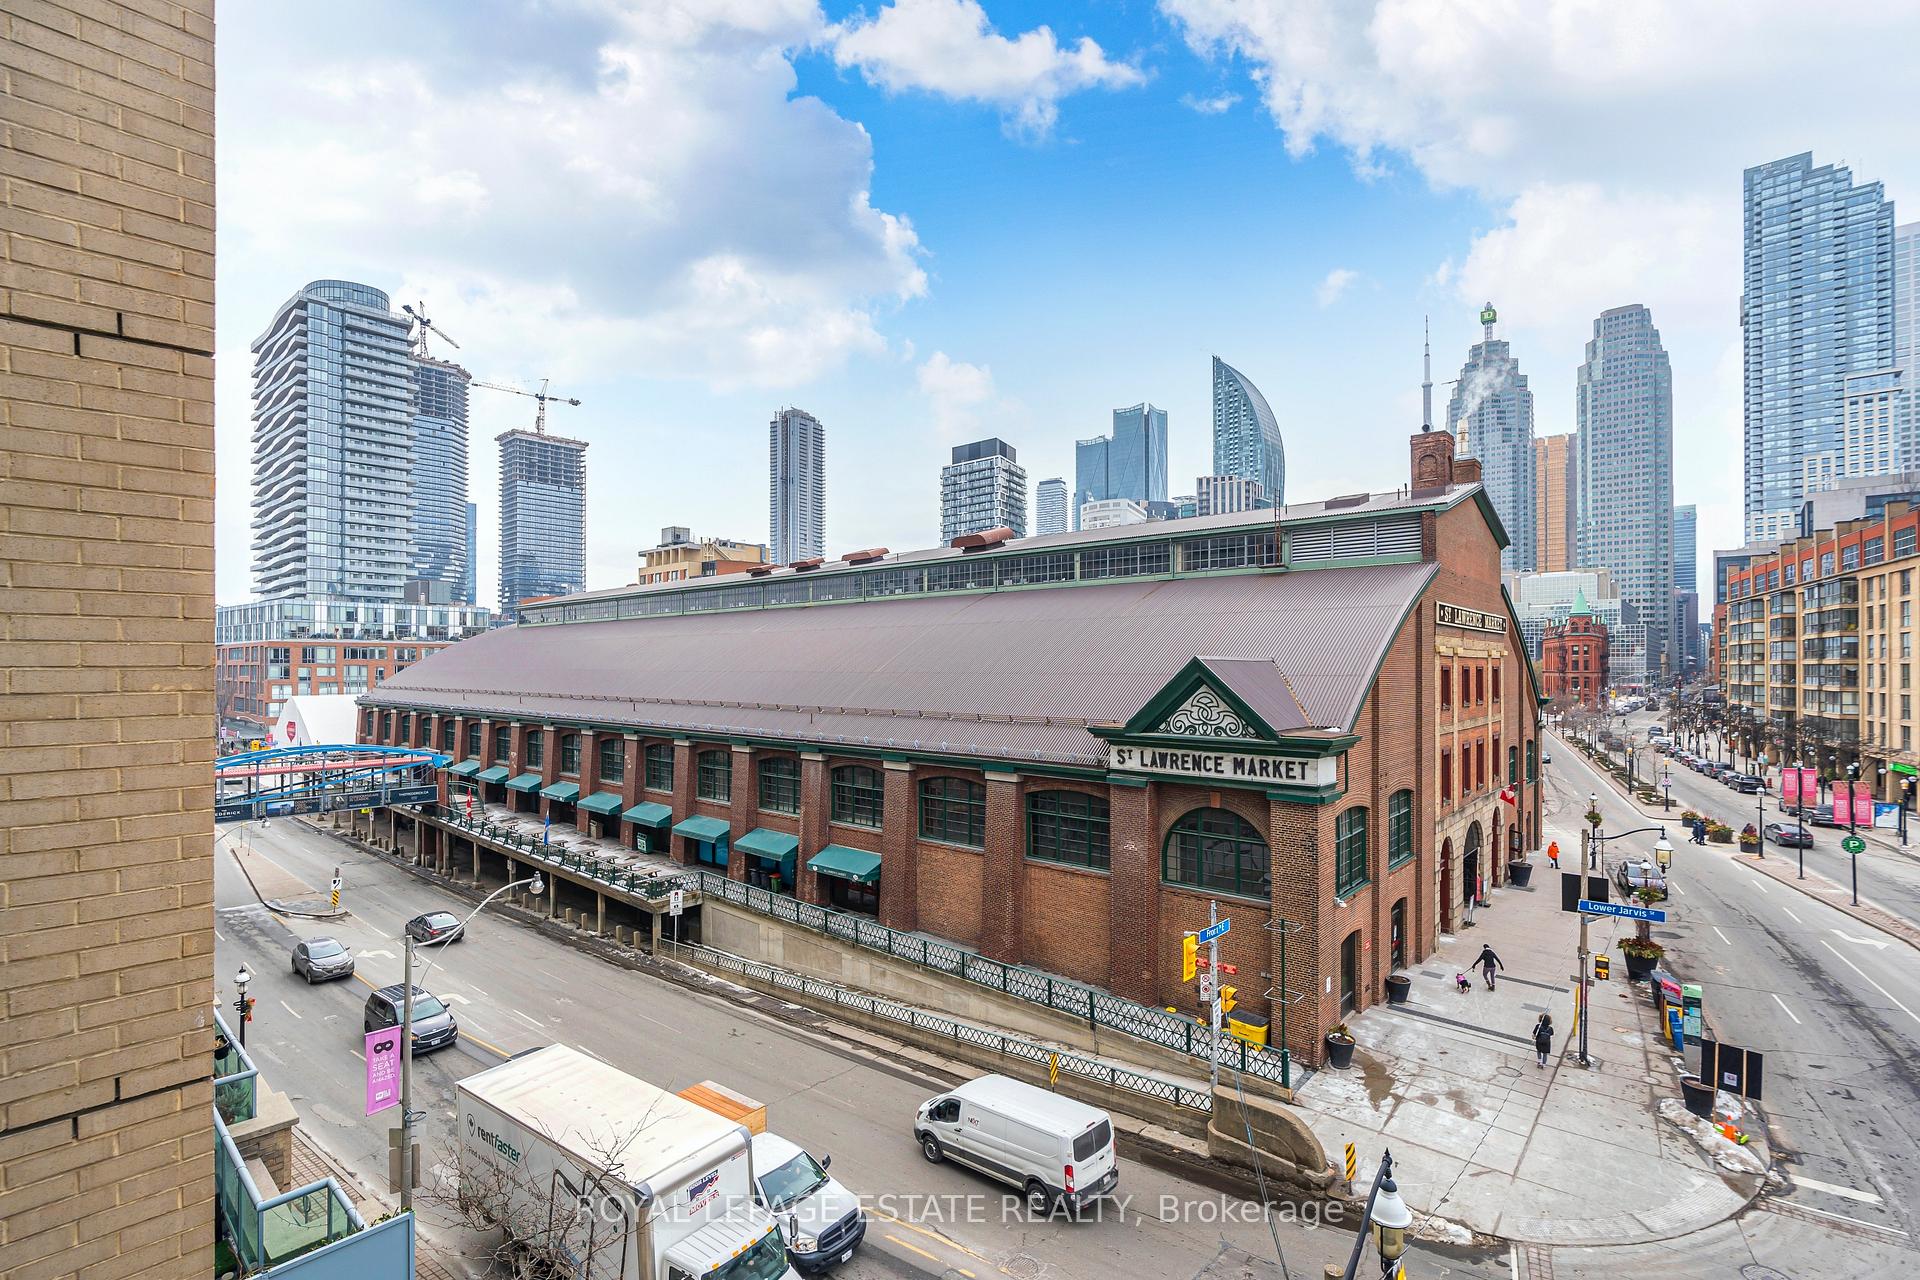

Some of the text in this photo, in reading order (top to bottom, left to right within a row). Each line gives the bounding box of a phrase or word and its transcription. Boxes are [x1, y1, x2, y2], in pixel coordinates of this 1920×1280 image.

[1482, 311, 1493, 320] TD
[1454, 609, 1482, 627] LAWRENCE
[1484, 615, 1503, 631] MARKET
[1139, 750, 1225, 774] LAWRENCE
[1232, 757, 1309, 781] MARKET
[1849, 840, 1859, 848] P
[1588, 902, 1617, 913] Lower
[1619, 906, 1648, 918] Jarvis
[373, 1054, 388, 1063] TAKE
[372, 1059, 394, 1072] SEAT
[372, 1069, 386, 1078] AND
[477, 1126, 521, 1163] rentfaster
